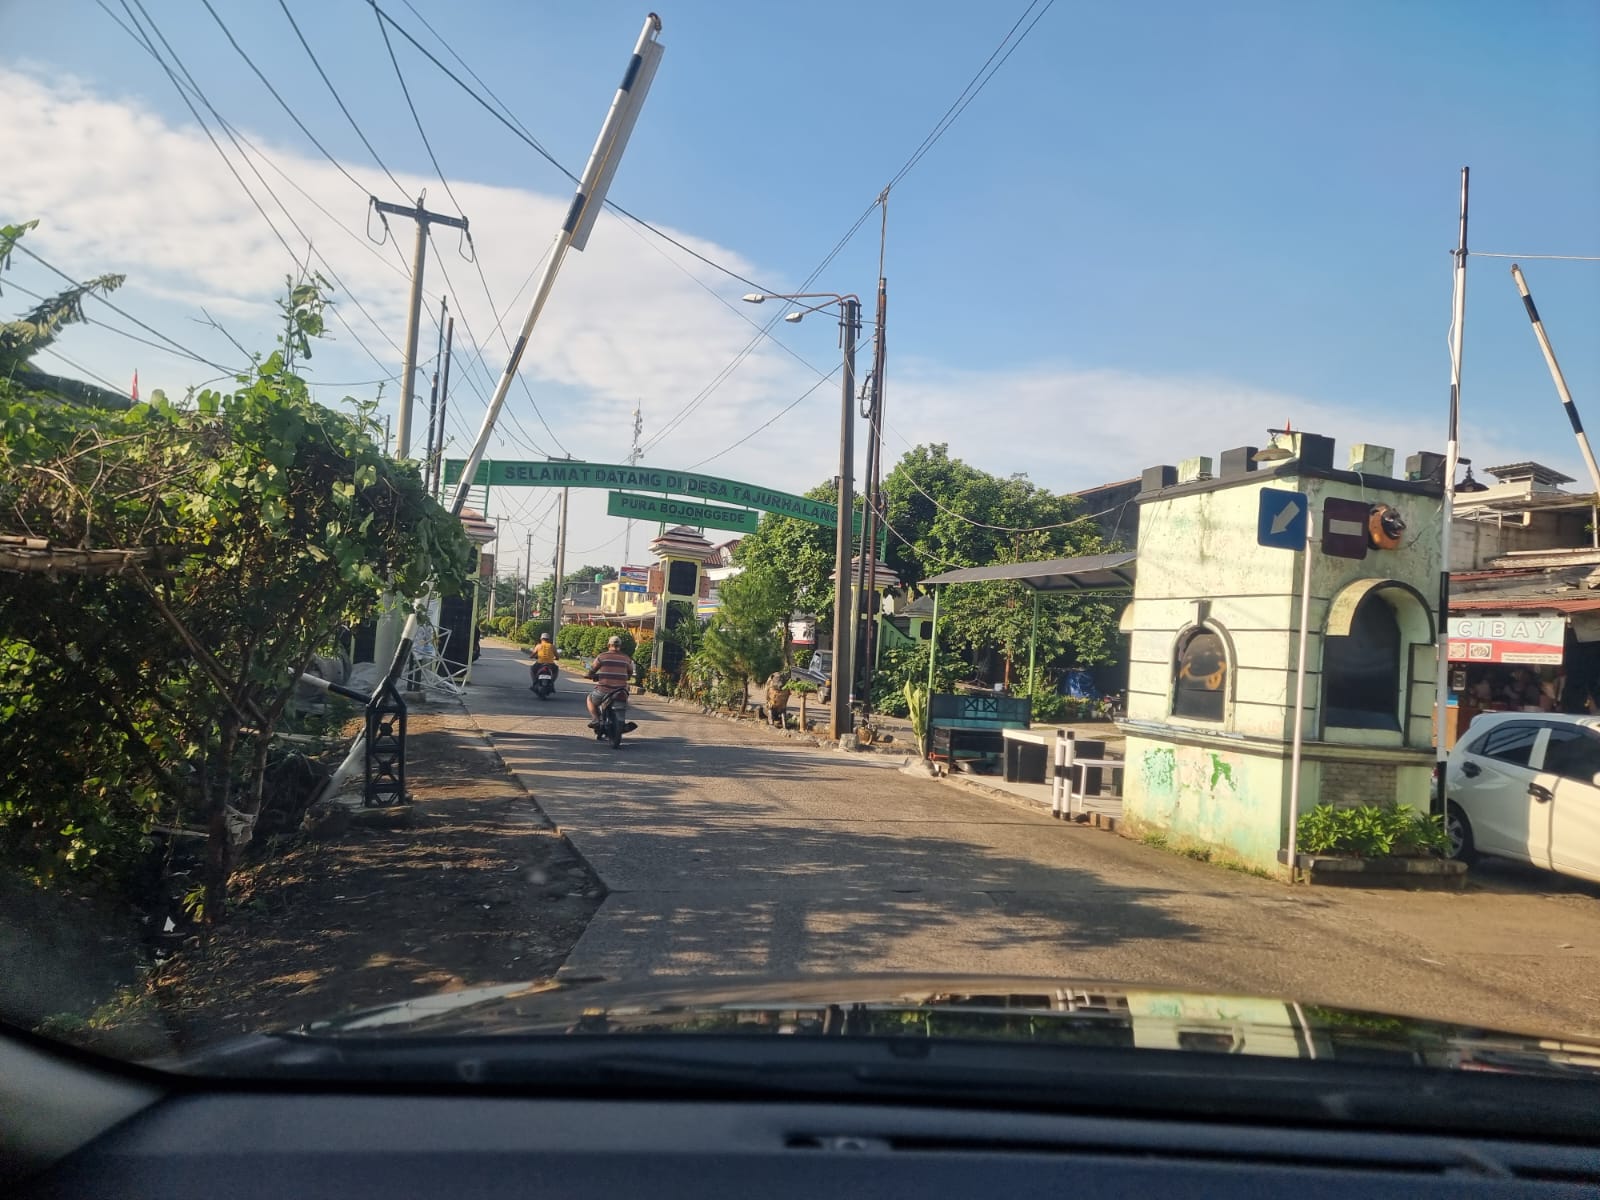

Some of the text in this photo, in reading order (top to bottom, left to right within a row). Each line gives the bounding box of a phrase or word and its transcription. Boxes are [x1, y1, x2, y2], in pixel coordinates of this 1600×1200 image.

[504, 466, 590, 482] SELAMAT
[595, 470, 662, 487] DATANG
[666, 475, 682, 489] DI
[687, 478, 728, 497] DESA
[621, 497, 656, 512] PURA
[660, 503, 745, 524] BOJONGGEDE
[1458, 620, 1551, 638] CIBAY
